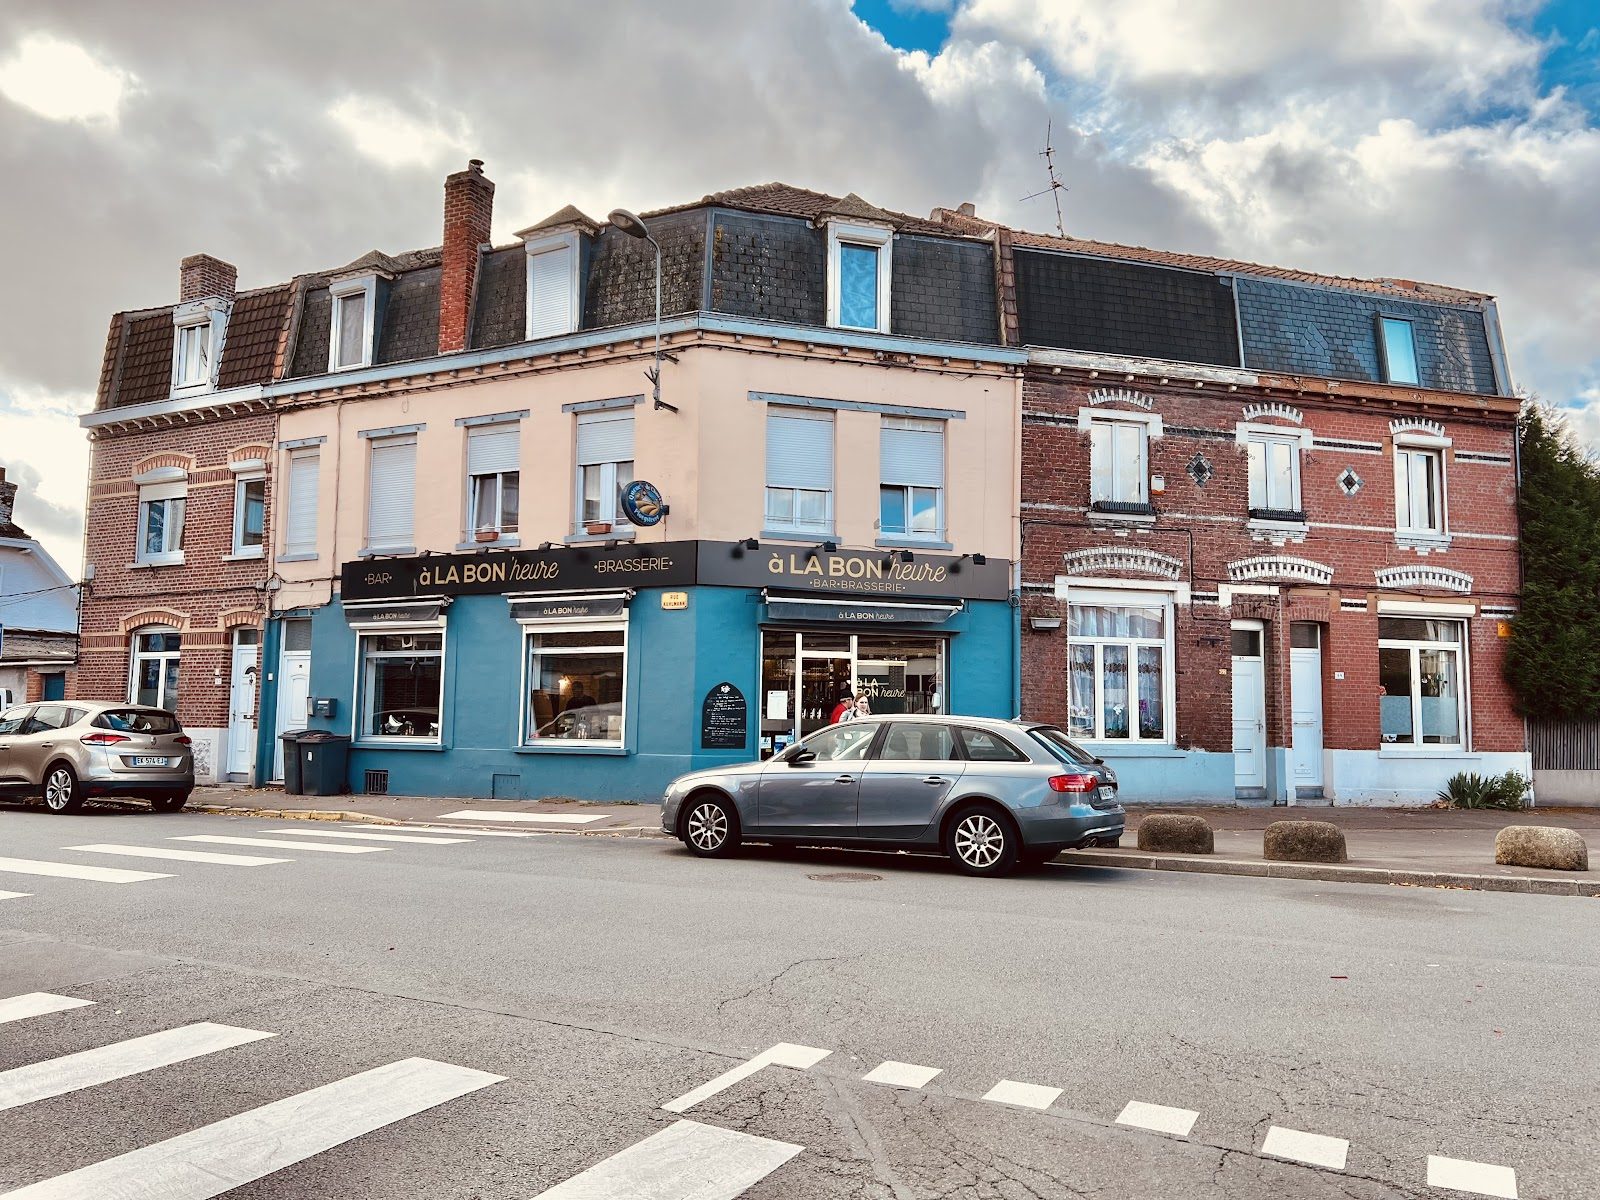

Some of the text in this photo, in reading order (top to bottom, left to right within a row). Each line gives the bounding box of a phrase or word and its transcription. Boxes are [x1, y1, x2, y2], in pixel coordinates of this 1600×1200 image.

[420, 567, 430, 585] à
[434, 566, 460, 584] LA
[464, 563, 505, 583] BON
[768, 553, 784, 573] à
[790, 554, 824, 575] LA
[829, 556, 882, 578] BON
[864, 678, 878, 687] LA
